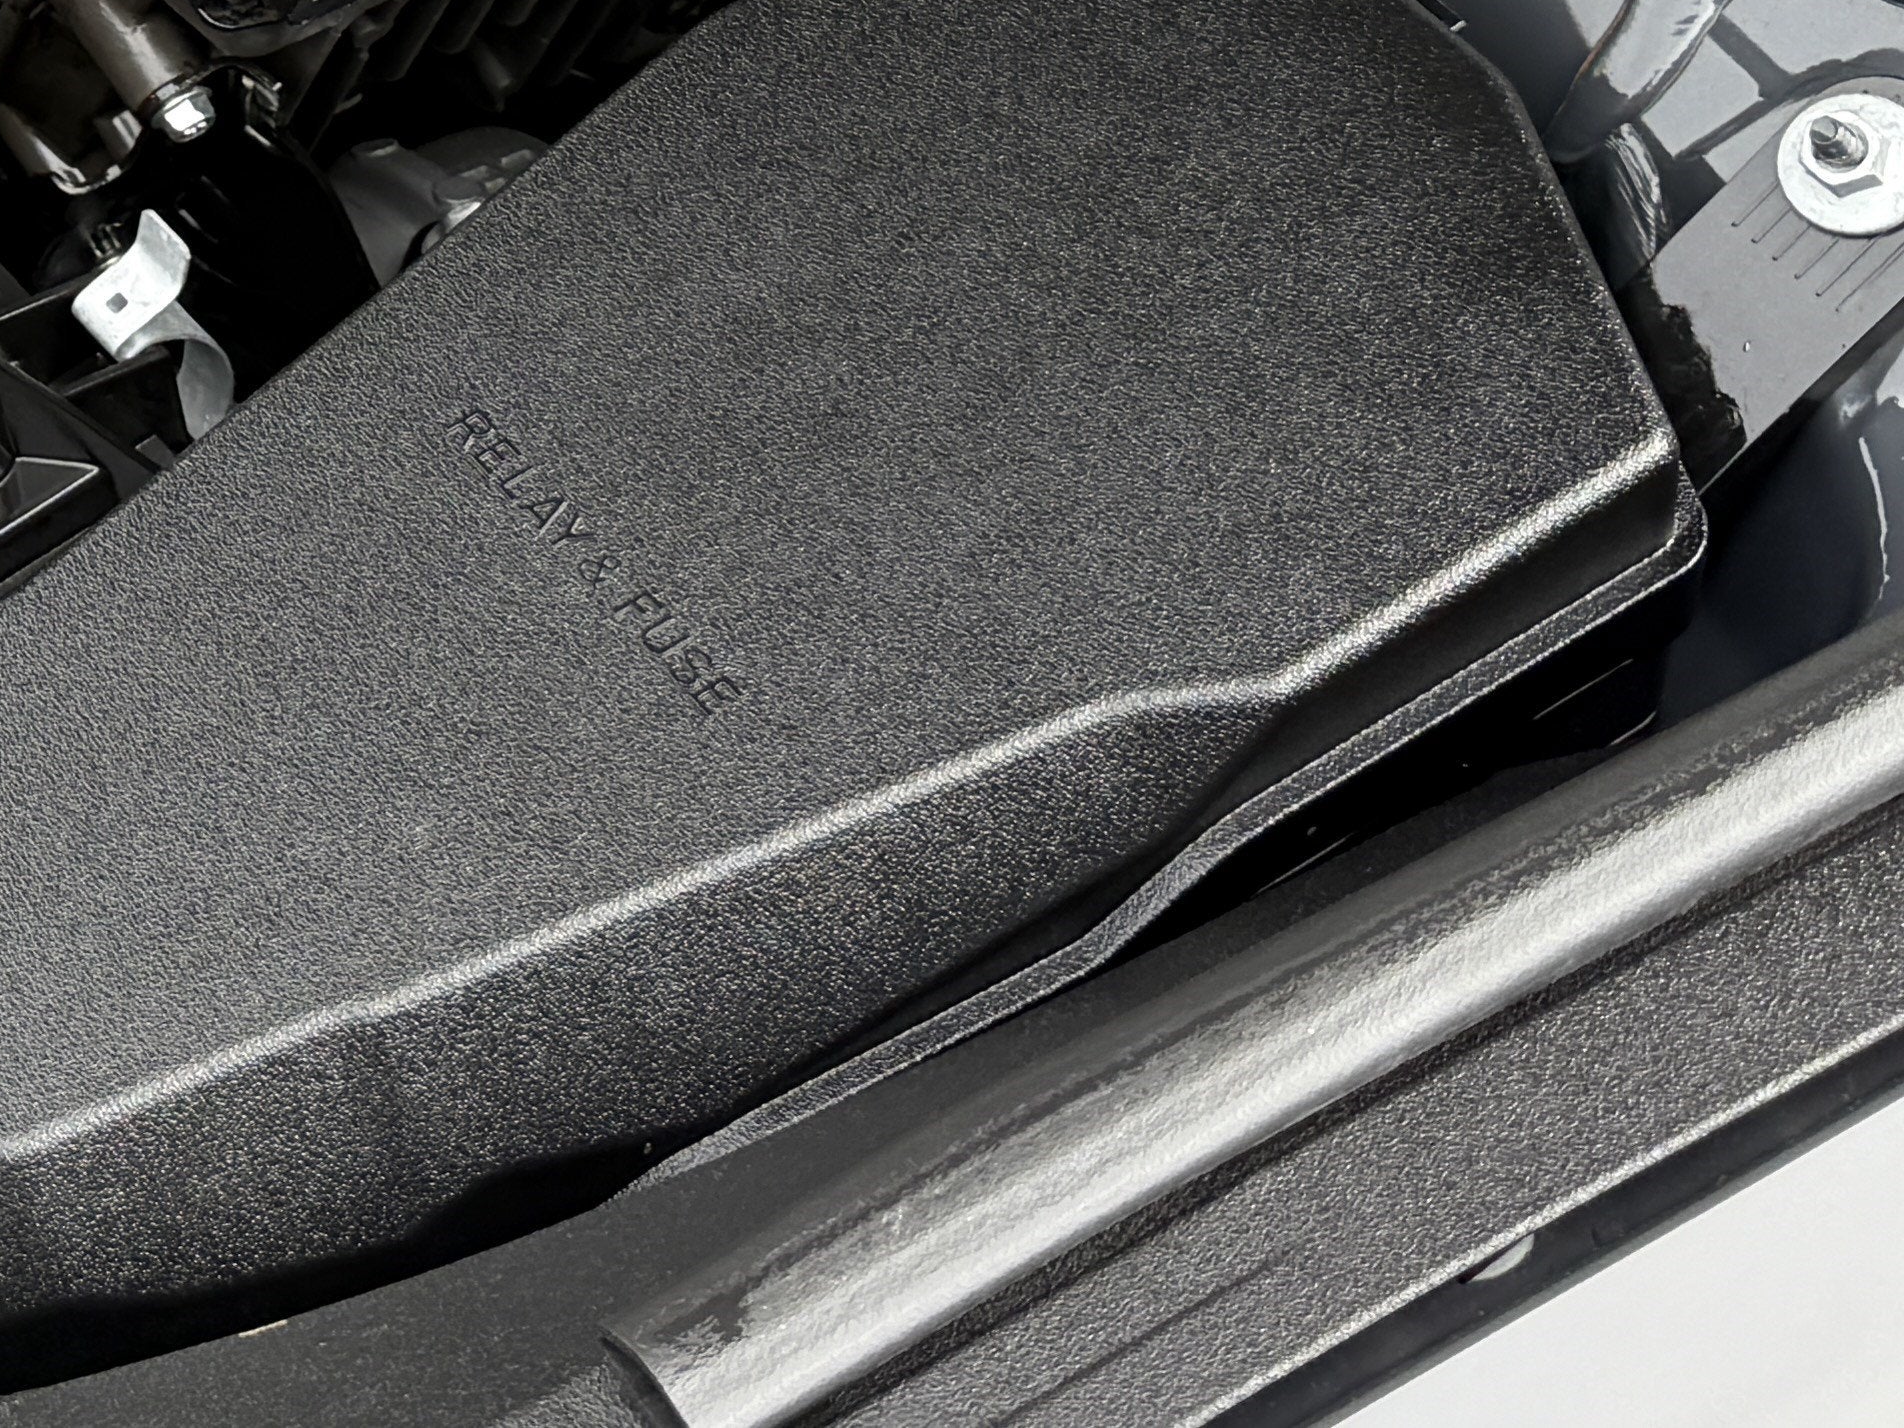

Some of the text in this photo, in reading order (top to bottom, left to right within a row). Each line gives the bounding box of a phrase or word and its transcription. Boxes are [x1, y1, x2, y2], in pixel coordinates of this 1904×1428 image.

[446, 410, 743, 716] RELAY & FUSE
